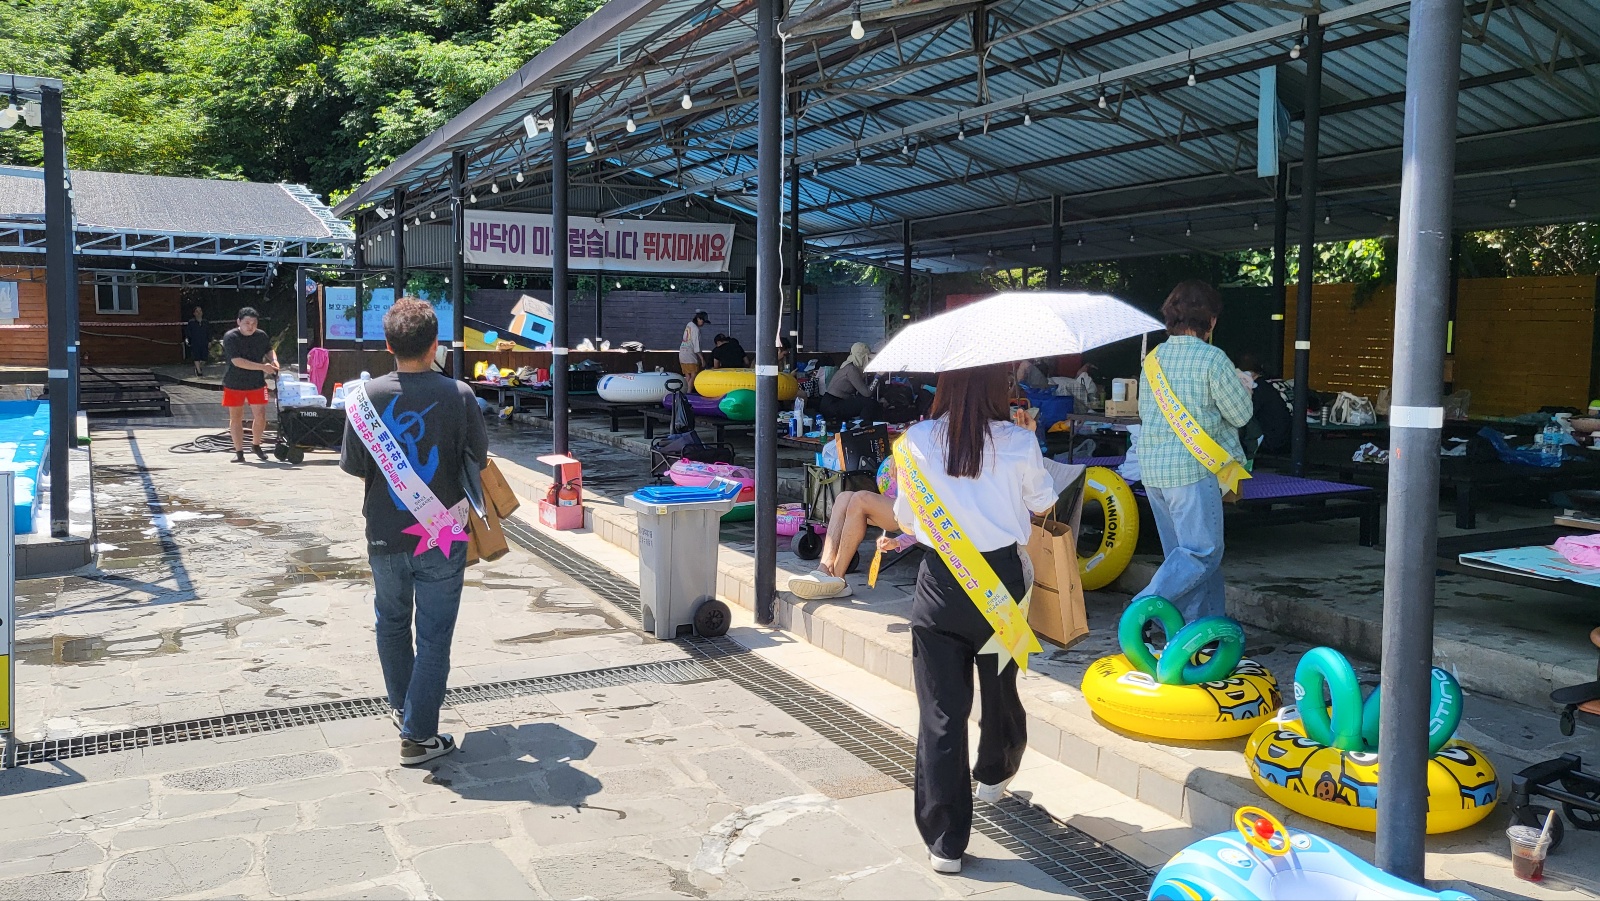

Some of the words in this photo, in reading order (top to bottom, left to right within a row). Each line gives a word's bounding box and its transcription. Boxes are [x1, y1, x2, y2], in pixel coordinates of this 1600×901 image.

[469, 222, 526, 255] 바닥이
[532, 226, 638, 261] 미럽습니다
[643, 232, 725, 262] 뛰지마세요
[378, 430, 408, 471] 배려하여
[931, 504, 963, 541] 배려가
[1105, 494, 1118, 548] MINIONS
